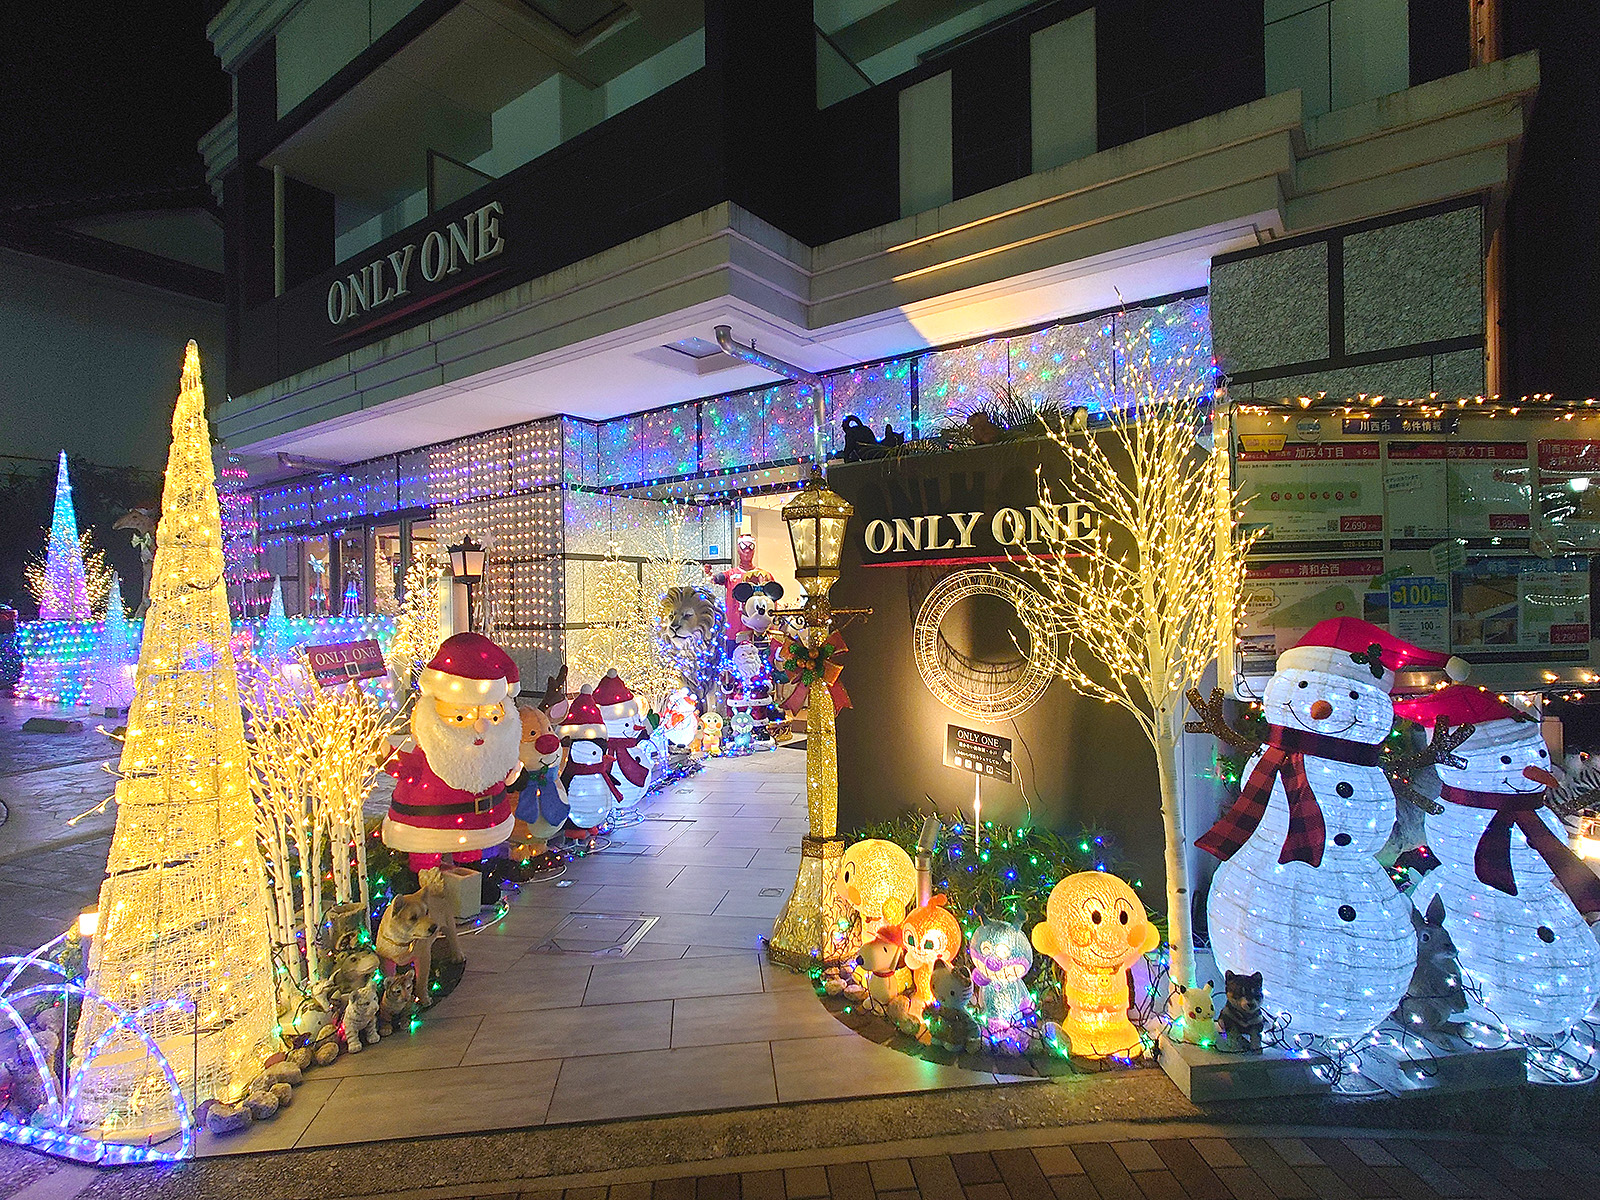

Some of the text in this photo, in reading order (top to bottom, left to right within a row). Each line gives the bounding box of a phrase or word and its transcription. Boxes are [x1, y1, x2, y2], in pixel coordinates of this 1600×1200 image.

[327, 200, 505, 325] ONLY ONE
[1360, 420, 1391, 431] 川西市
[864, 502, 1099, 554] ONLY ONE
[1299, 563, 1340, 576] 清和台西
[315, 646, 378, 666] ONLY ONE
[957, 729, 980, 743] ONLY
